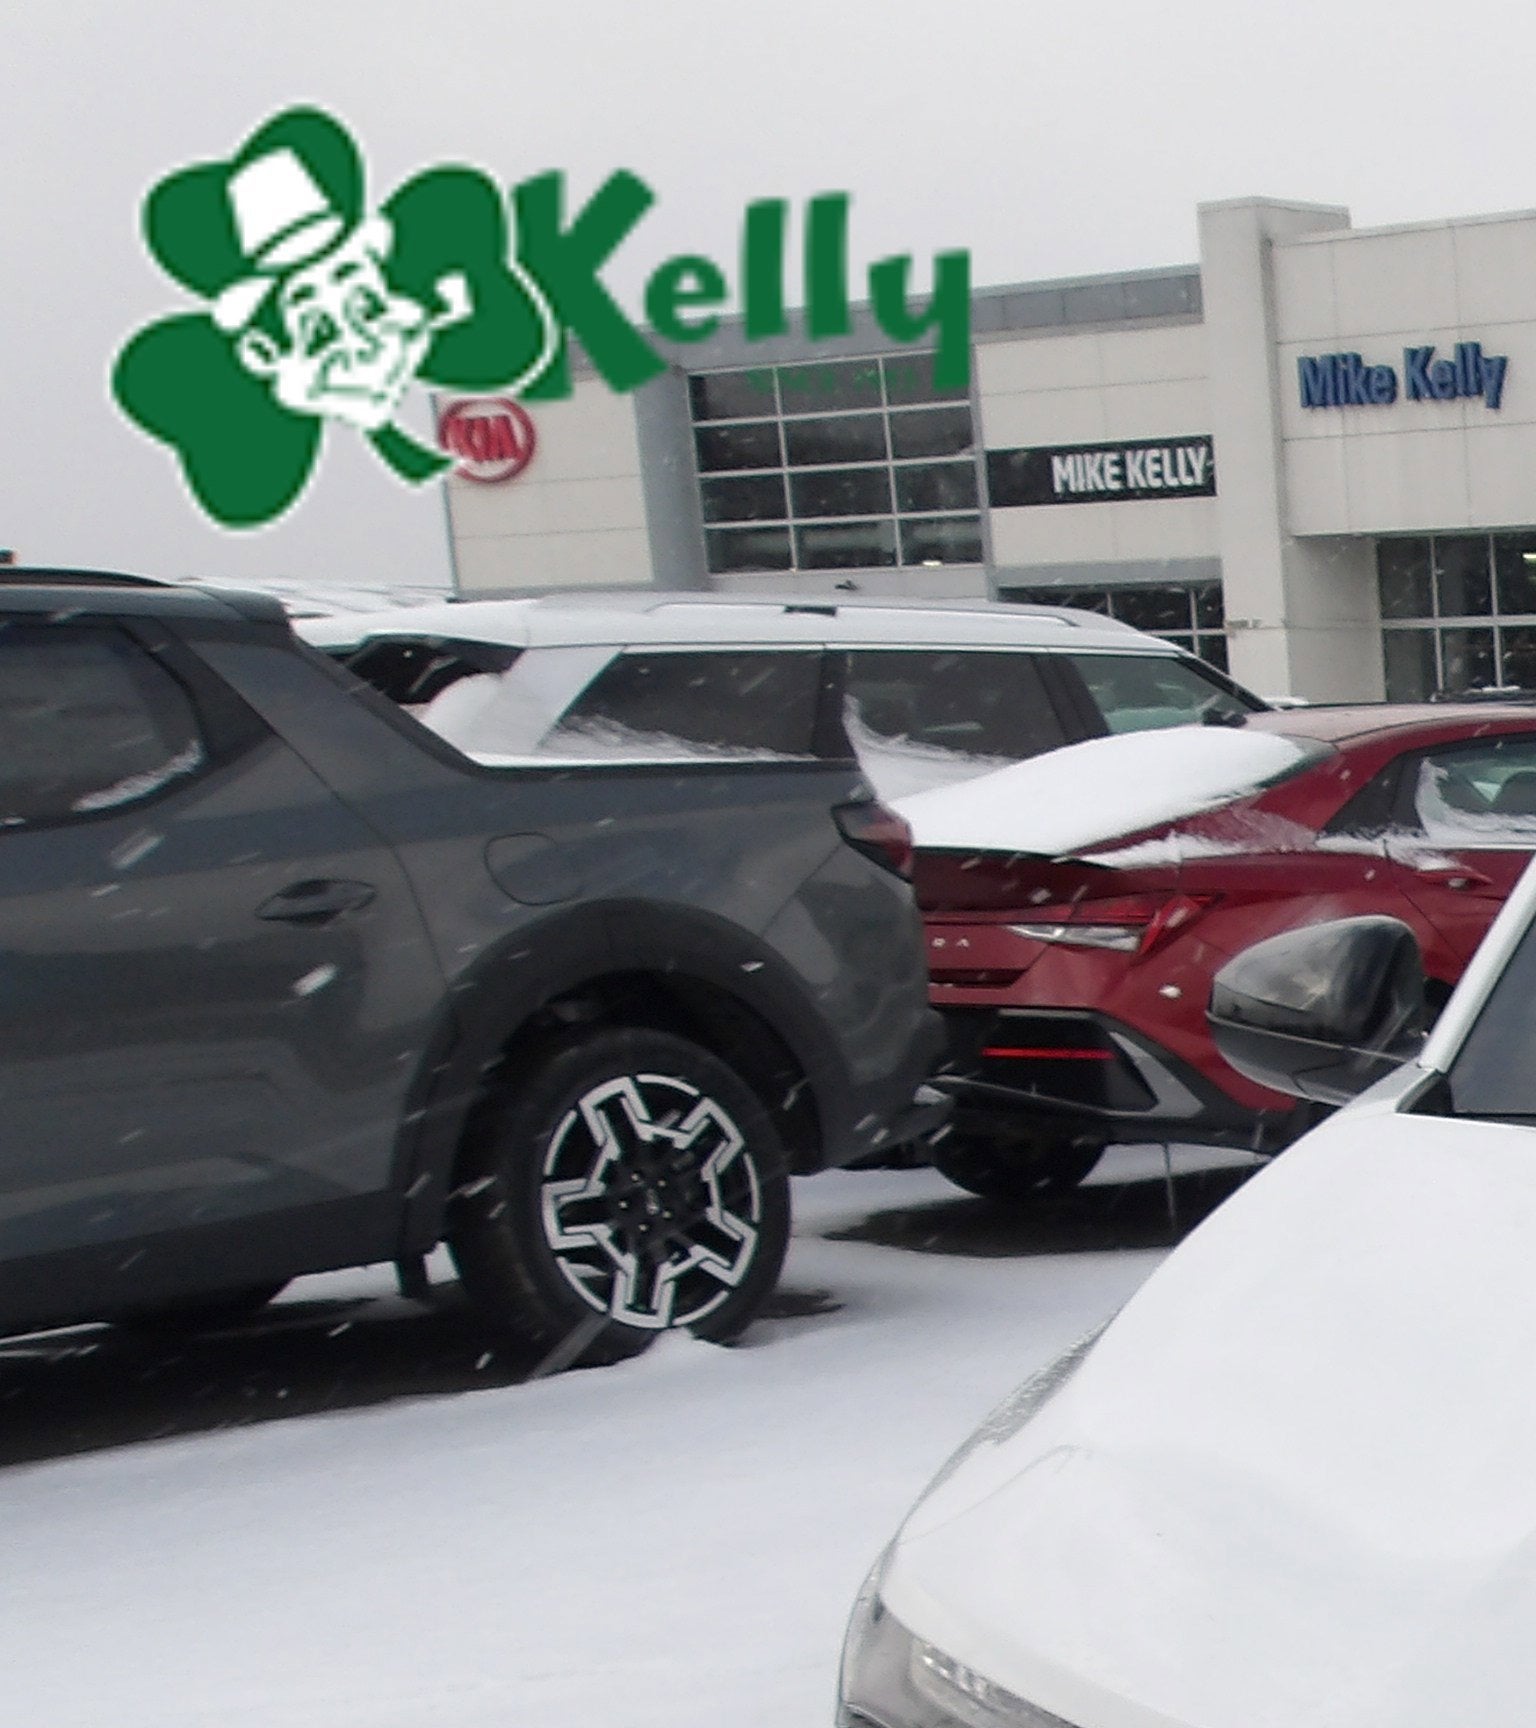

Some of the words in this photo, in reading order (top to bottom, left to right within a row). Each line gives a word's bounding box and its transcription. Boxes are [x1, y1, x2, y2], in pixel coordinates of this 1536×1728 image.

[1298, 352, 1397, 408] Mike
[1403, 341, 1508, 410] Kelly
[1052, 453, 1124, 494] MIKE
[1126, 446, 1209, 488] KELLY
